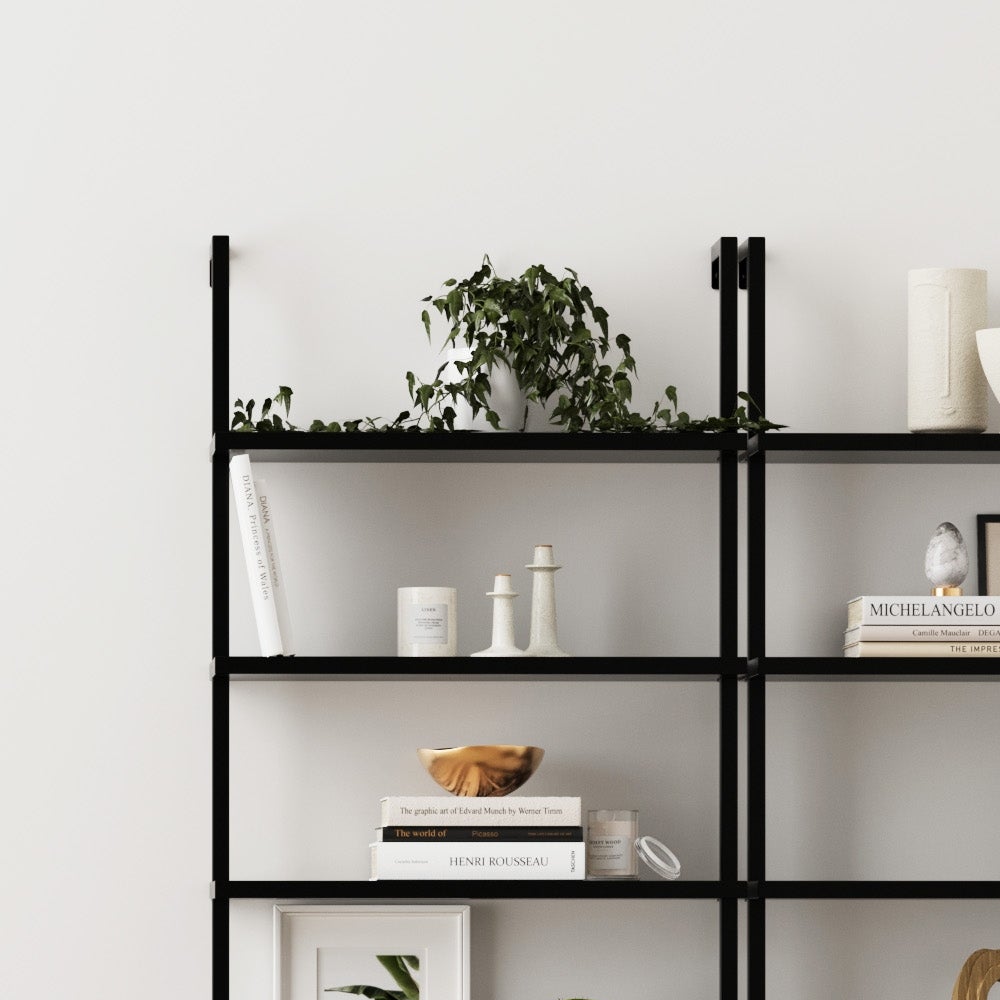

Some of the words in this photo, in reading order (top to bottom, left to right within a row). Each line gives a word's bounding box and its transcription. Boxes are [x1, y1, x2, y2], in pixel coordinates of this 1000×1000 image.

[260, 495, 271, 525] DIANA
[249, 515, 262, 556] Princess
[258, 558, 265, 569] of
[260, 572, 269, 601] Wales
[870, 603, 996, 617] MICHELANGELO
[912, 629, 939, 637] Camille
[940, 629, 971, 637] Mauclair
[950, 645, 967, 653] THE
[400, 807, 413, 816] The
[414, 807, 438, 818] graphic
[439, 807, 449, 815] art
[450, 807, 459, 815] of
[459, 807, 483, 816] Edvard
[484, 807, 507, 816] Munch
[508, 807, 516, 818] by
[518, 807, 541, 815] Werner
[544, 807, 563, 815] Timm
[396, 829, 410, 838] The
[412, 829, 436, 838] world
[437, 829, 447, 838] of
[471, 830, 499, 838] Picasso
[449, 857, 486, 867] HENRI
[489, 857, 549, 867] ROUSSEAU
